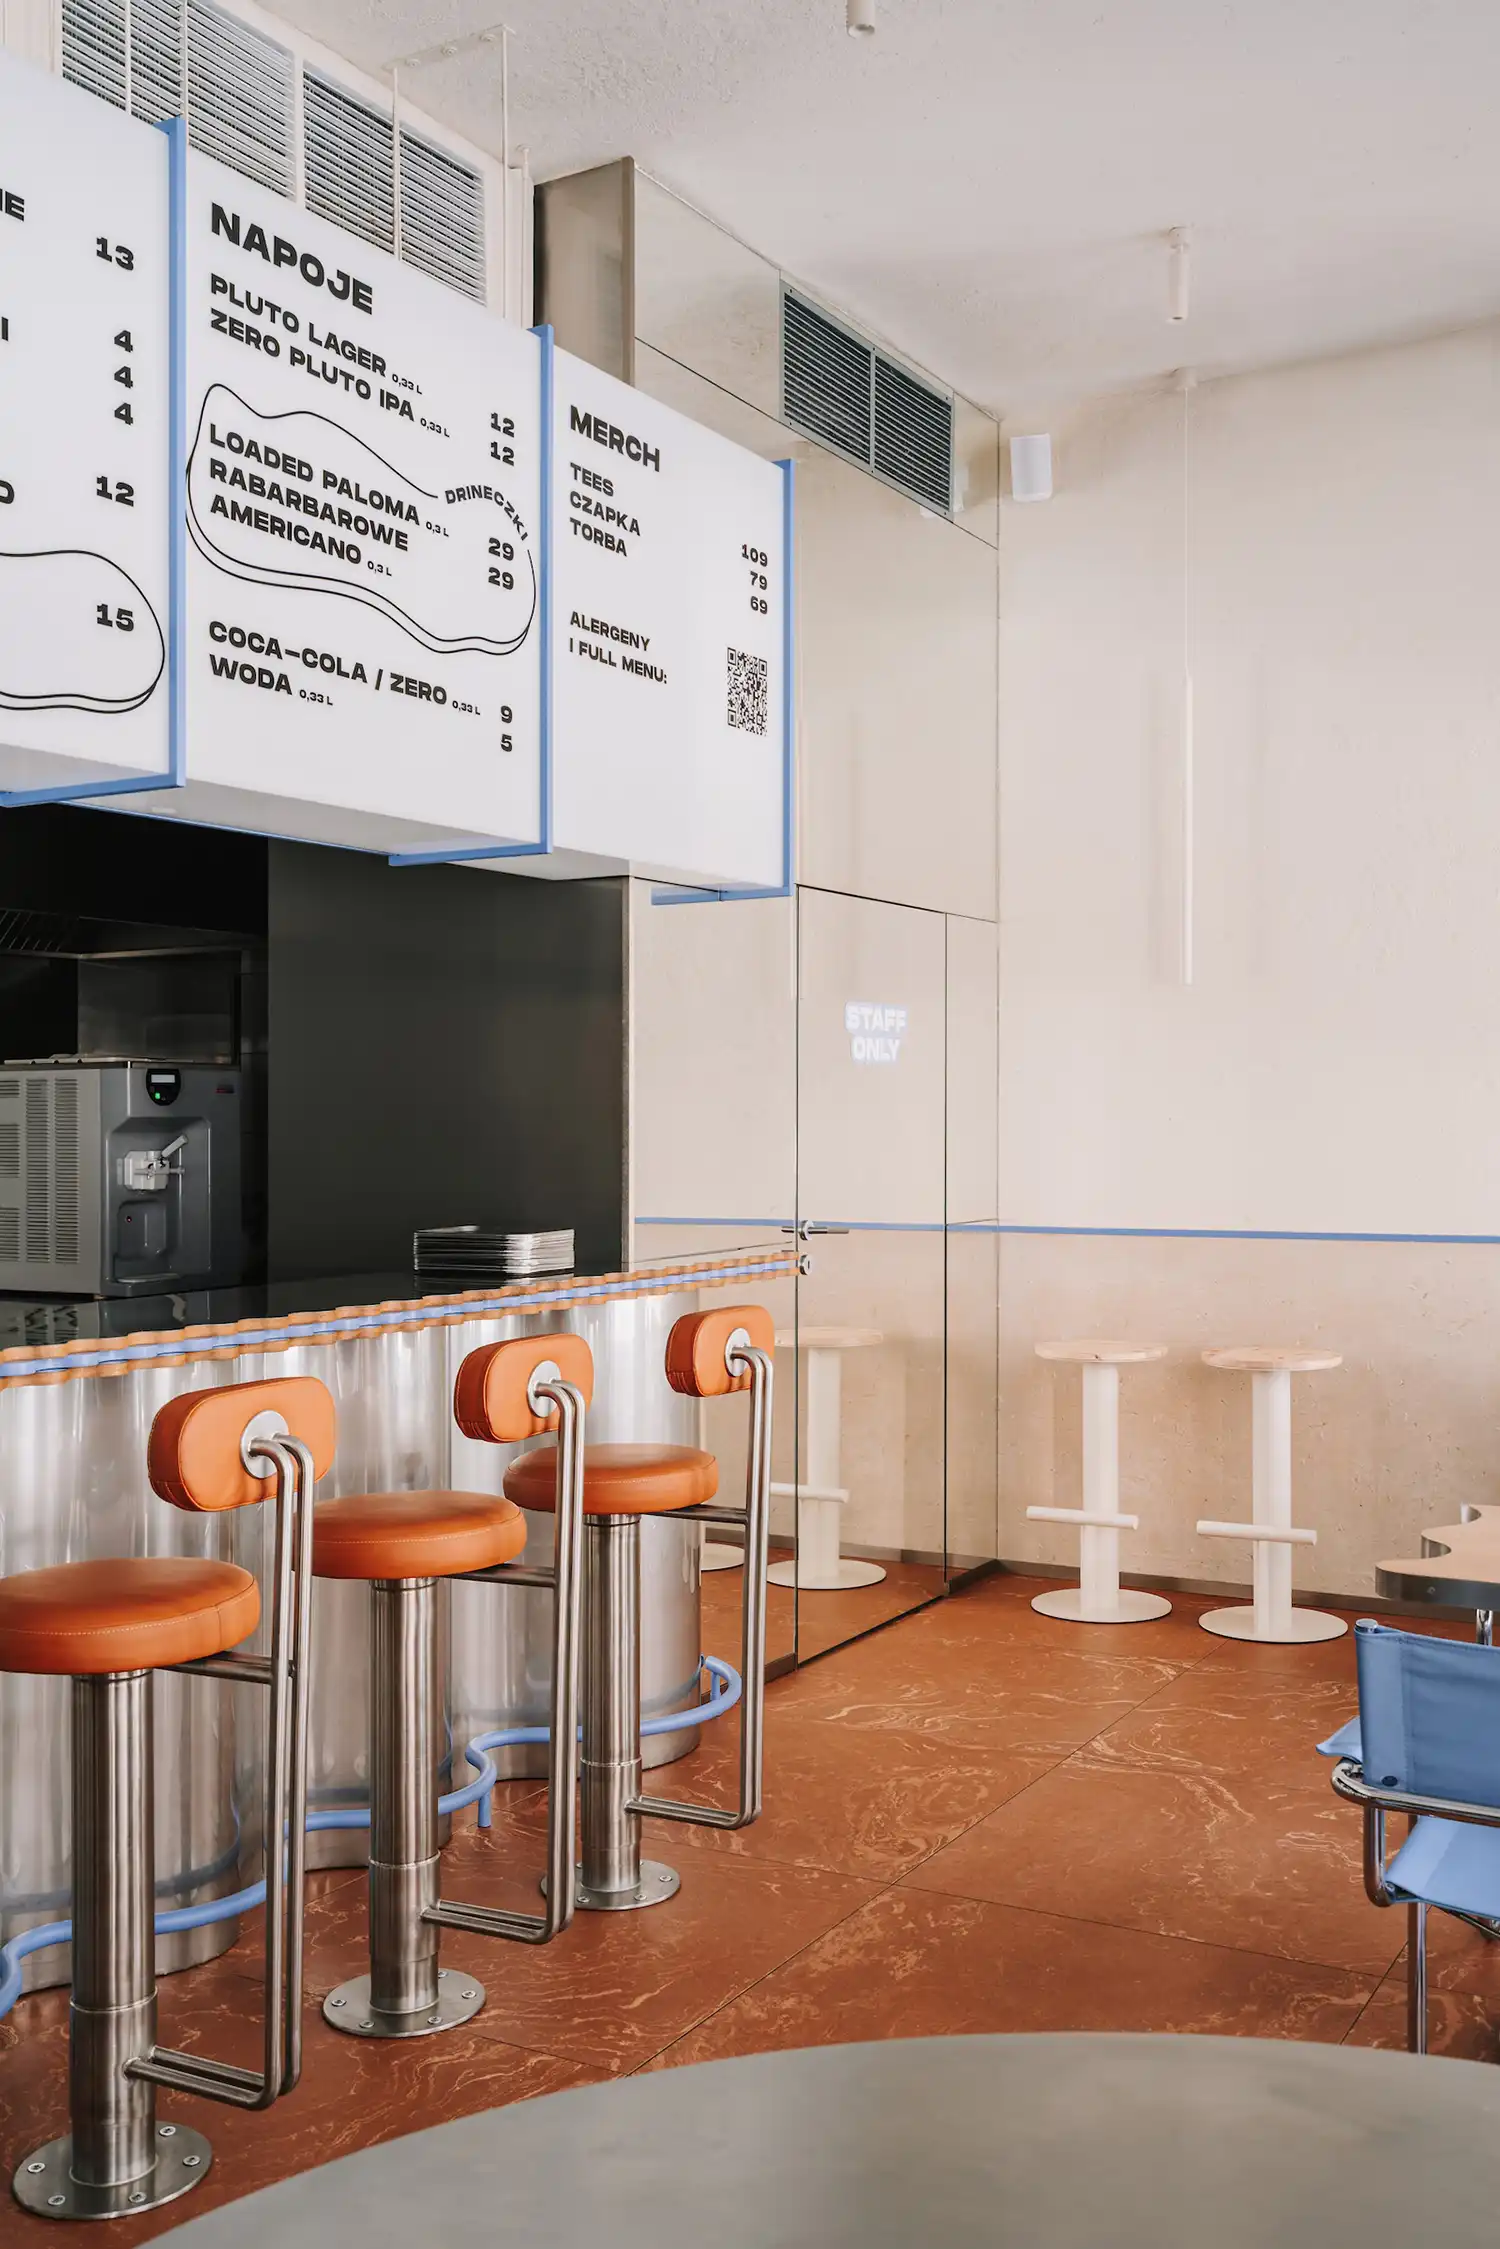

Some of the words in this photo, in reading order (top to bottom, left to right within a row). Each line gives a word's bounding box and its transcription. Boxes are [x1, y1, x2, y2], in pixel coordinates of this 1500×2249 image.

[96, 236, 135, 271] 13
[211, 201, 373, 316] NAPOJE
[113, 329, 134, 353] 4
[210, 272, 300, 334] PLUTO
[308, 321, 387, 378] LAGER
[391, 373, 415, 391] 0,33
[113, 365, 134, 389] 4
[210, 307, 281, 358] ZERO
[289, 345, 372, 401] PLUTO
[379, 388, 415, 422] IPA
[420, 417, 442, 434] 0,33
[114, 402, 134, 426] 4
[490, 412, 515, 438] 12
[490, 441, 515, 467] 12
[570, 404, 660, 473] MERCH
[96, 475, 135, 508] 12
[210, 422, 314, 483] LOADED
[322, 469, 420, 526] PALOMA
[425, 521, 441, 534] 0,3
[570, 462, 614, 497] TEES
[210, 457, 408, 552] RABARBAROWE
[444, 484, 529, 541] DRINECZKI
[569, 490, 641, 537] CZAPKA
[210, 494, 362, 565] AMERICANO
[367, 560, 384, 575] 0,3
[488, 537, 515, 562] 29
[569, 516, 628, 557] TORBA
[741, 544, 768, 568] 109
[488, 566, 515, 591] 29
[749, 570, 768, 591] 79
[96, 603, 135, 632] 15
[749, 596, 768, 615] 69
[570, 611, 651, 652] ALERGENY
[209, 620, 368, 684] COCA-COLA
[374, 668, 384, 691] /
[390, 672, 447, 705] ZERO
[451, 700, 473, 714] 0,33
[569, 637, 574, 653] I
[578, 640, 617, 668] FULL
[621, 655, 668, 685] MENU:
[209, 653, 293, 696] WODA
[299, 689, 325, 704] 0,33
[500, 705, 513, 724] 9
[500, 733, 513, 753] 5
[845, 1004, 907, 1032] STAFF
[851, 1035, 902, 1062] ONLY
